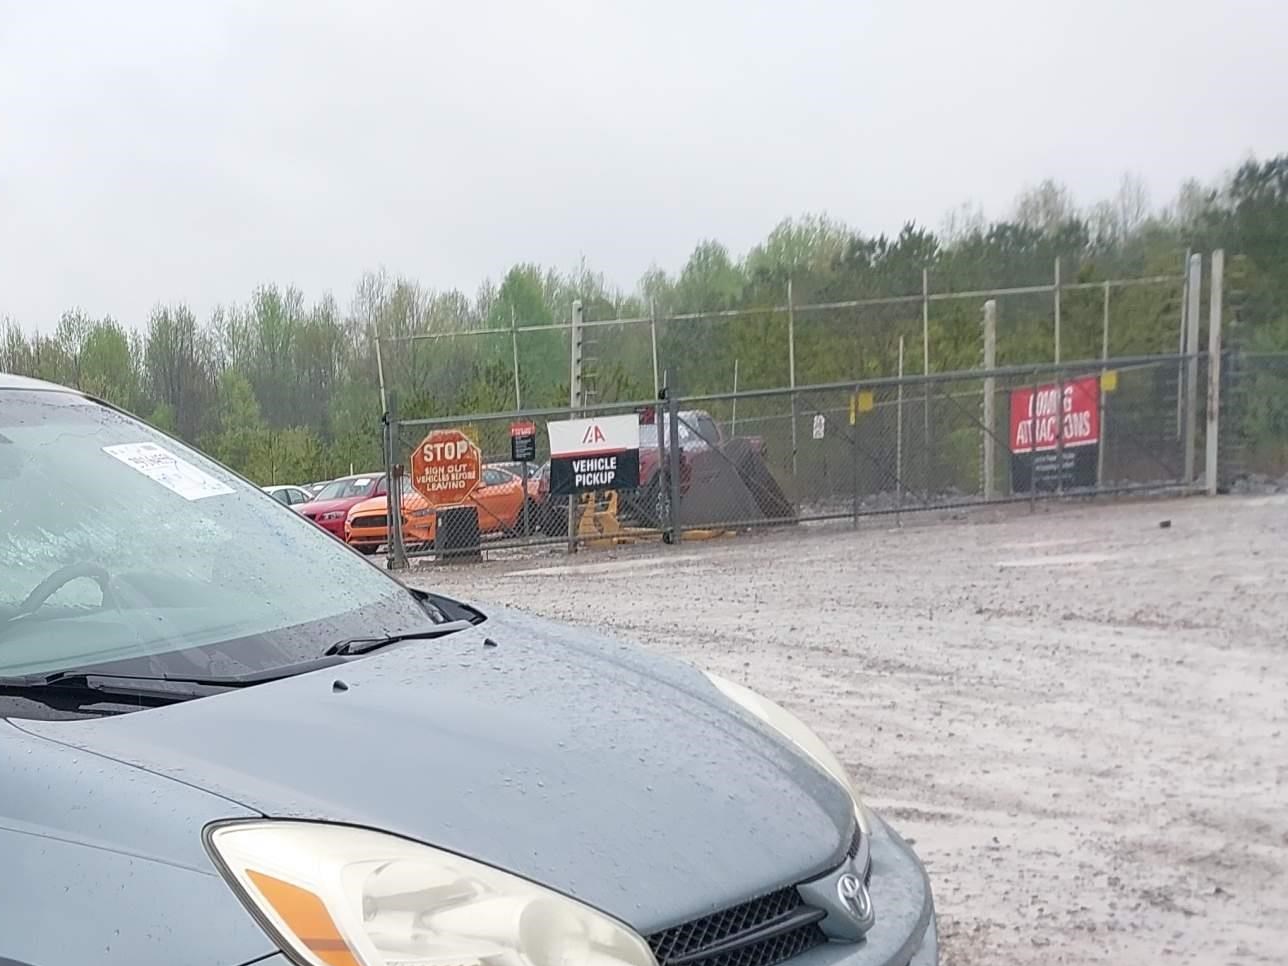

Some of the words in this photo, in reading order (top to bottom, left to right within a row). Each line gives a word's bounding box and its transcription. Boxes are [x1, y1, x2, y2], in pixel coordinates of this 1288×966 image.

[1016, 410, 1091, 446] ATTACONS
[423, 440, 468, 462] STOP
[425, 465, 445, 475] SIGN
[447, 463, 467, 473] OUT
[572, 456, 617, 473] VEHICLE
[416, 473, 450, 484] VEHICLES
[426, 480, 466, 491] LEAVING
[575, 471, 615, 487] PICKUP
